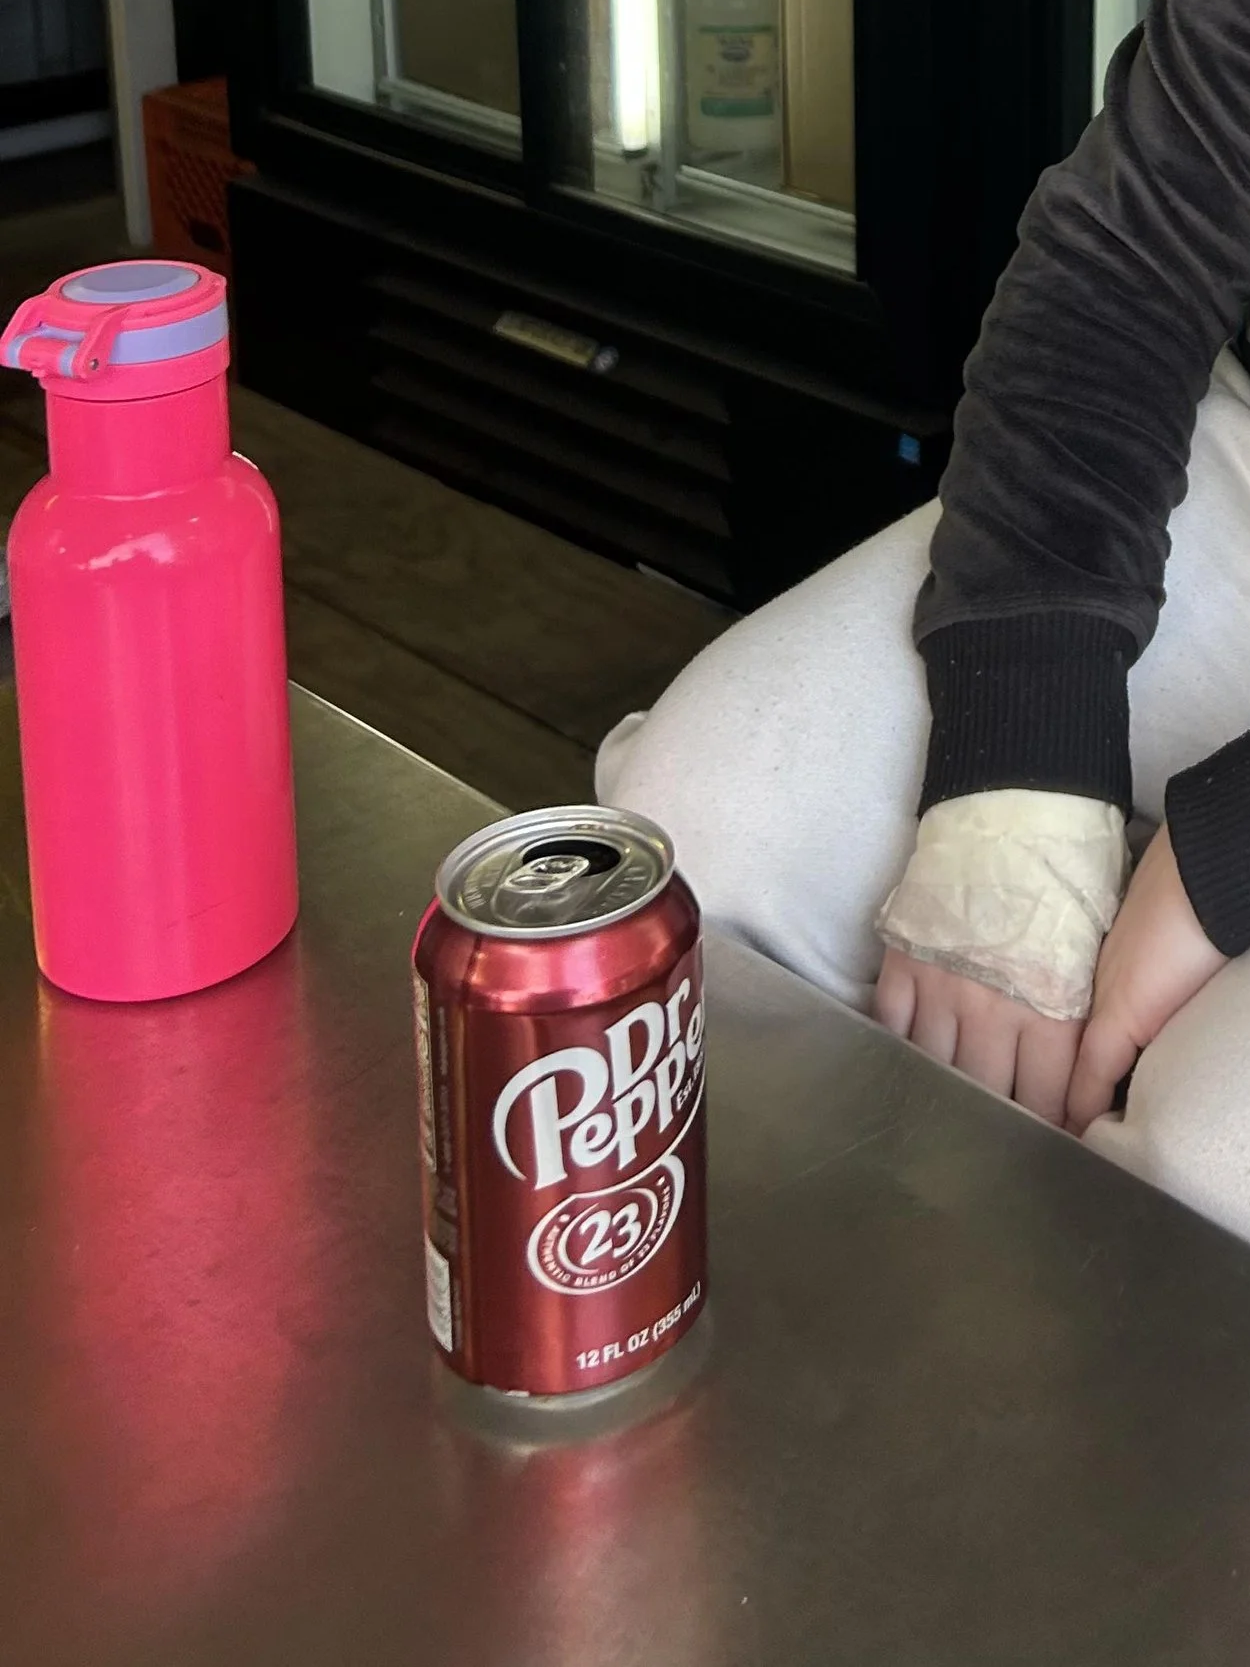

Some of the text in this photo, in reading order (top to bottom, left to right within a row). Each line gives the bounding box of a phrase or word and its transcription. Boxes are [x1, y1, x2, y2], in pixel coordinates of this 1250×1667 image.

[605, 977, 691, 1100] Dr
[492, 1002, 704, 1190] Peppe
[580, 1202, 642, 1266] 23
[576, 1347, 600, 1370] 12
[603, 1340, 625, 1363] FL
[627, 1326, 650, 1353] OZ
[652, 1303, 682, 1341] (355
